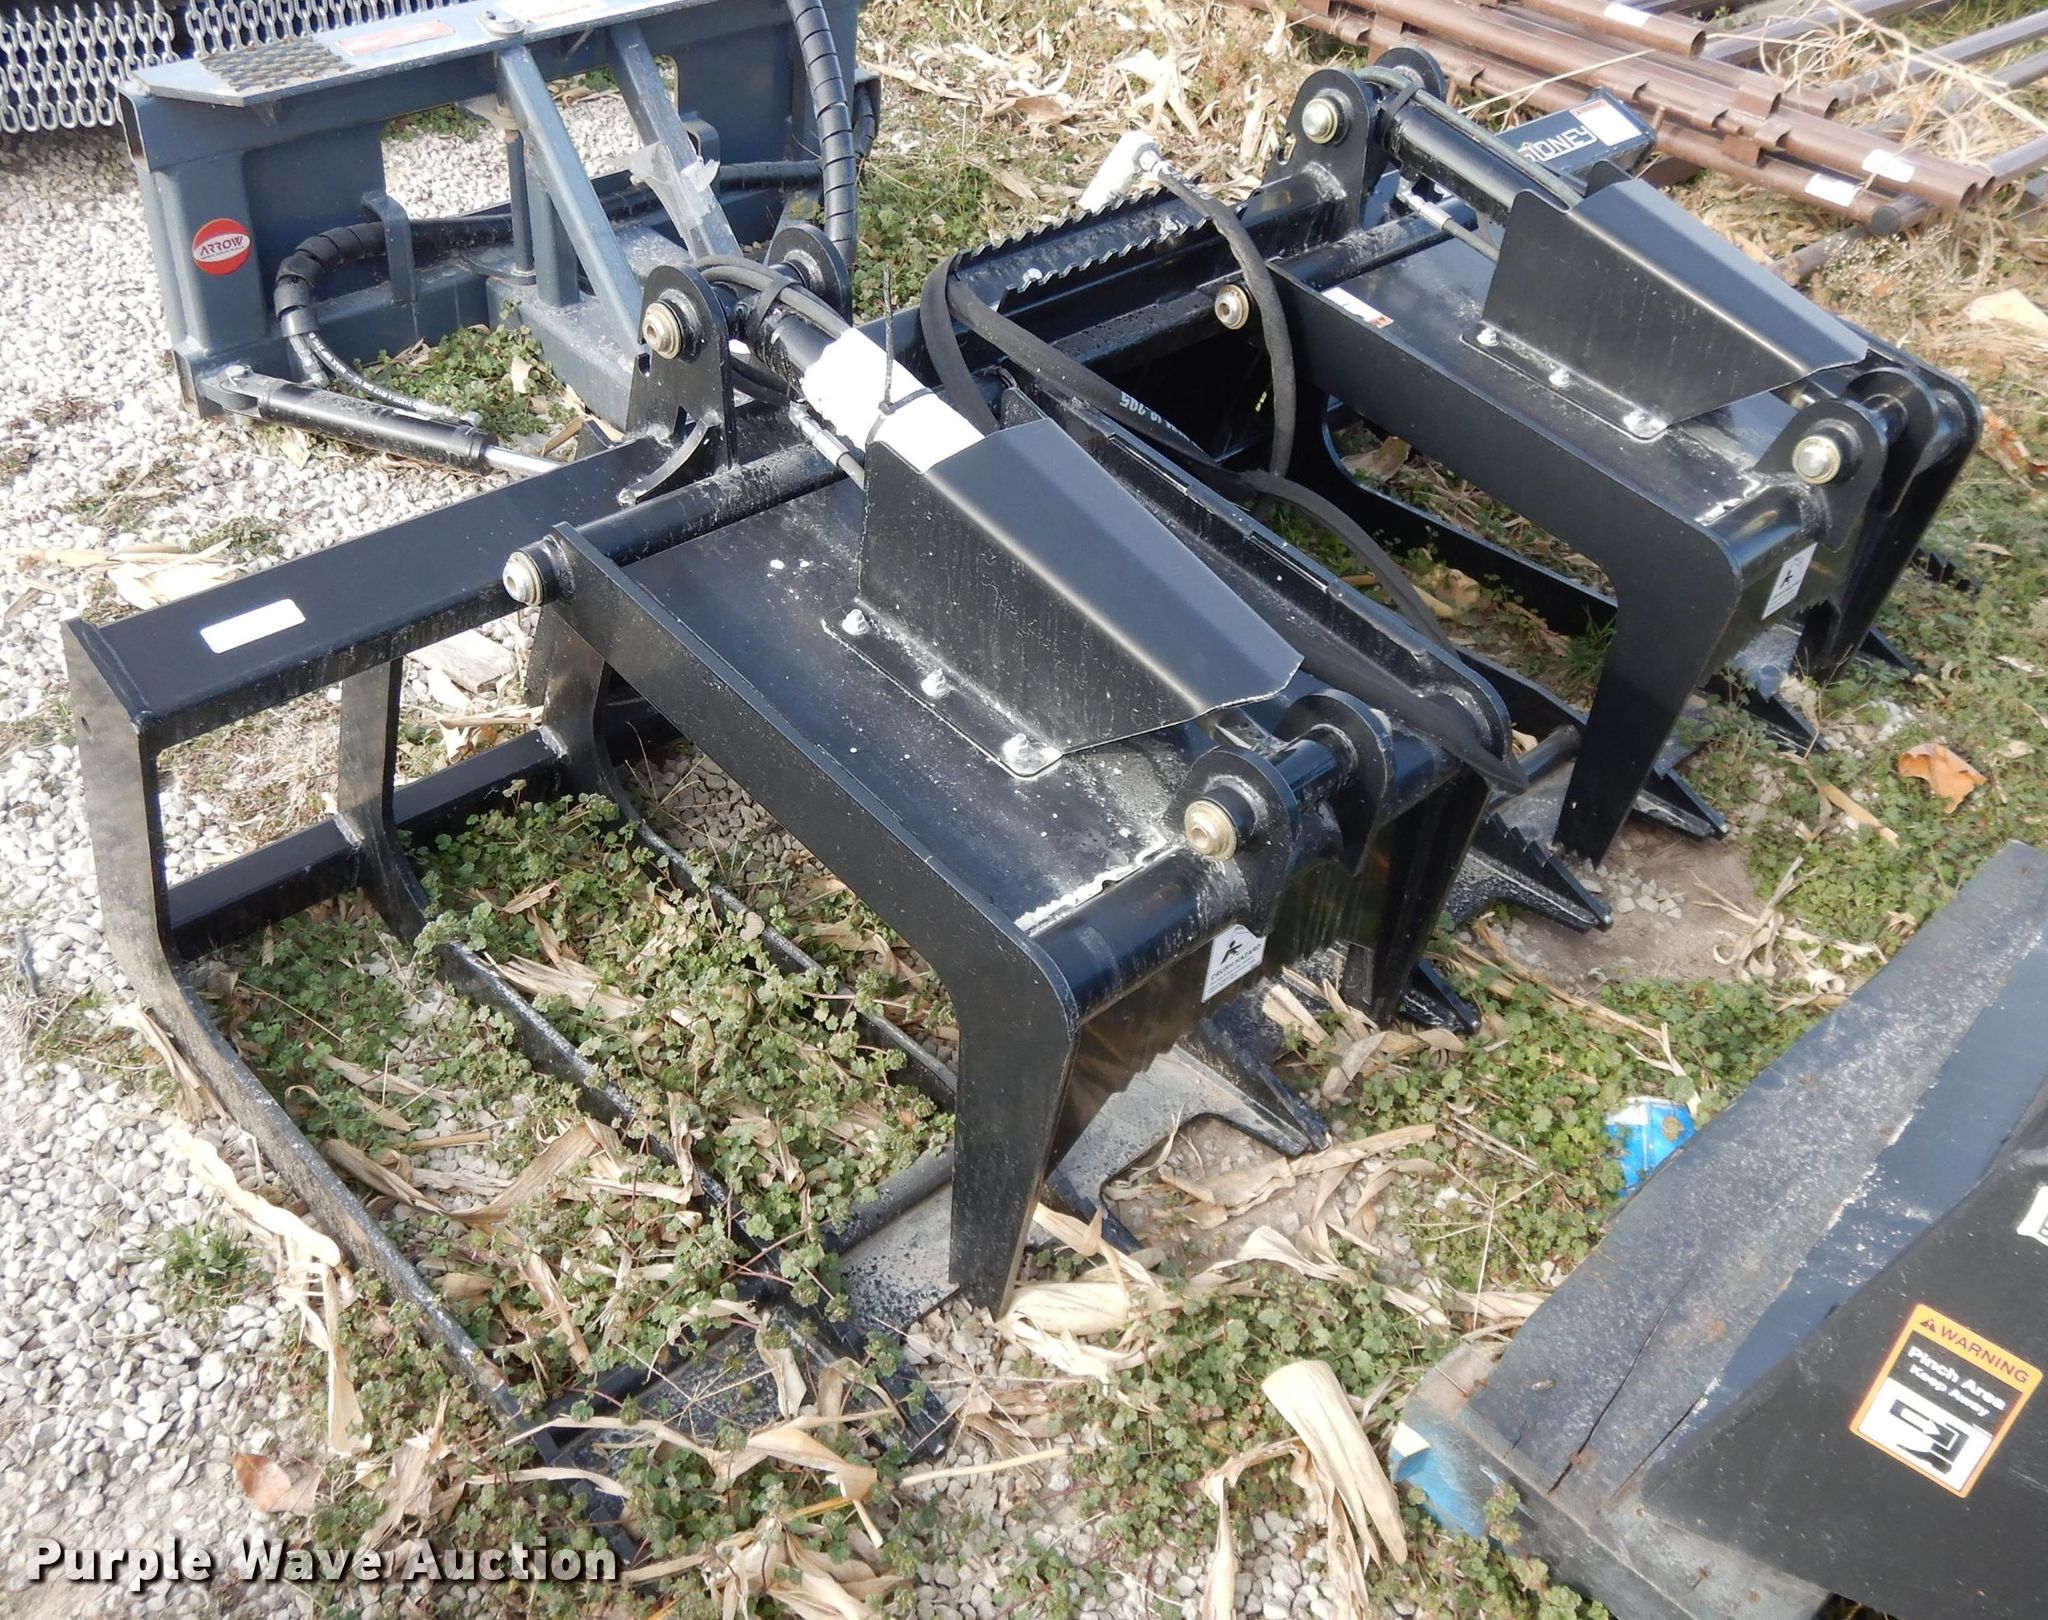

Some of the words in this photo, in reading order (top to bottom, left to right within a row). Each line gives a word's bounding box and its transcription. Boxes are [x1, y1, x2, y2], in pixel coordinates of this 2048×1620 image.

[200, 235, 243, 256] ARROW
[1907, 1345, 1960, 1384] Pinch
[1961, 1378, 2007, 1411] Area
[1940, 1324, 2030, 1385] WARNING
[1909, 1364, 1948, 1393] Keep
[1948, 1388, 1991, 1418] Away
